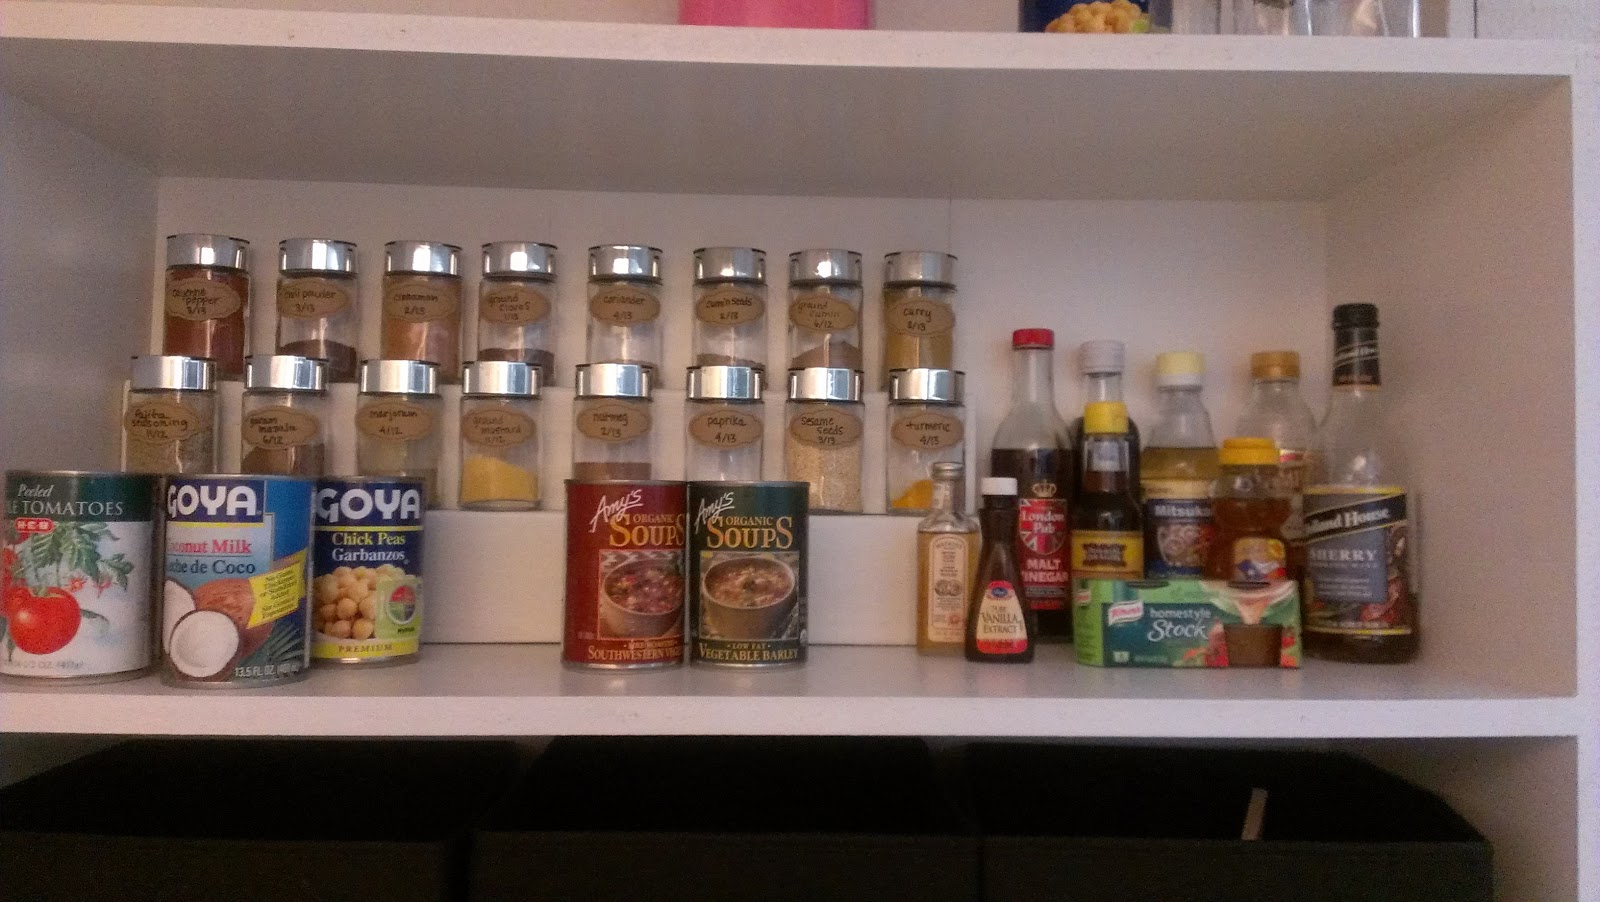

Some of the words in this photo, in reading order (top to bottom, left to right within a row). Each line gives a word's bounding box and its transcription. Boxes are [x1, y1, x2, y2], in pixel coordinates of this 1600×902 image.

[185, 295, 221, 306] pepper
[303, 289, 336, 300] powder
[903, 307, 932, 323] curry
[134, 408, 169, 420] fajita
[592, 413, 628, 426] nutmeg
[131, 418, 188, 430] seasoning
[707, 416, 746, 430] paprika
[801, 416, 834, 427] sesame
[906, 422, 950, 433] turmeric
[817, 426, 845, 435] seeds
[714, 433, 737, 443] 4/13
[818, 436, 835, 445] 3/13
[17, 483, 54, 497] Peeled
[167, 484, 257, 518] GOYA
[316, 488, 420, 523] GOYA
[22, 500, 124, 516] TOMATOES
[588, 488, 644, 534] Amy's
[694, 491, 735, 535] Amy's
[632, 514, 676, 523] ORGANIC
[725, 517, 774, 526] ORGANIC
[1022, 511, 1064, 521] London
[1033, 521, 1055, 533] Pub
[332, 532, 373, 546] Chick
[377, 532, 406, 546] Peas
[211, 539, 252, 554] Milk
[332, 548, 405, 561] Garbanzos
[190, 559, 207, 573] de
[212, 559, 256, 574] Coco
[1027, 559, 1061, 570] MALT
[980, 612, 1018, 624] VANILLA
[1150, 608, 1212, 619] homestyle
[983, 625, 1018, 633] EXTRACT
[1148, 619, 1208, 642] Stock
[338, 644, 393, 653] PREMIUM
[587, 645, 663, 660] SOUTHWESTERN
[700, 642, 761, 661] VEGETABLE
[763, 648, 799, 660] BARLEY
